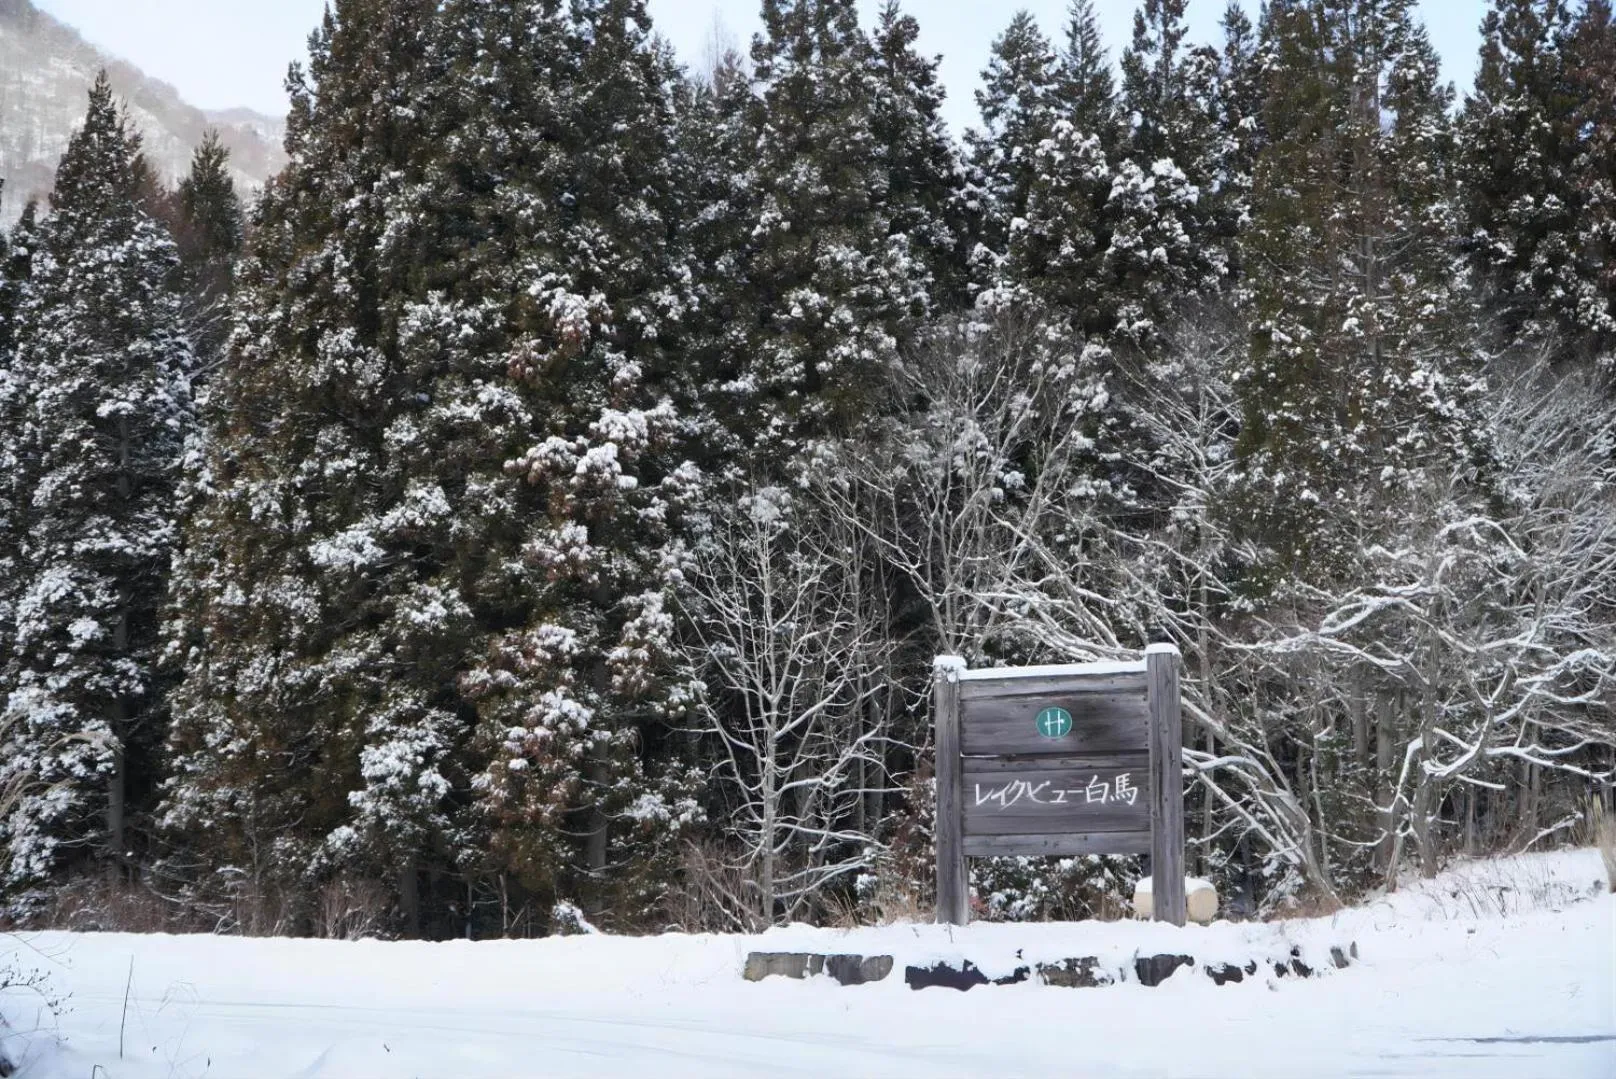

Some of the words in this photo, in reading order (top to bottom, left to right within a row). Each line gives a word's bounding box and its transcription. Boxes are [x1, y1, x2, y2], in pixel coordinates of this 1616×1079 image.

[975, 772, 1139, 811] レイクビュー白馬
